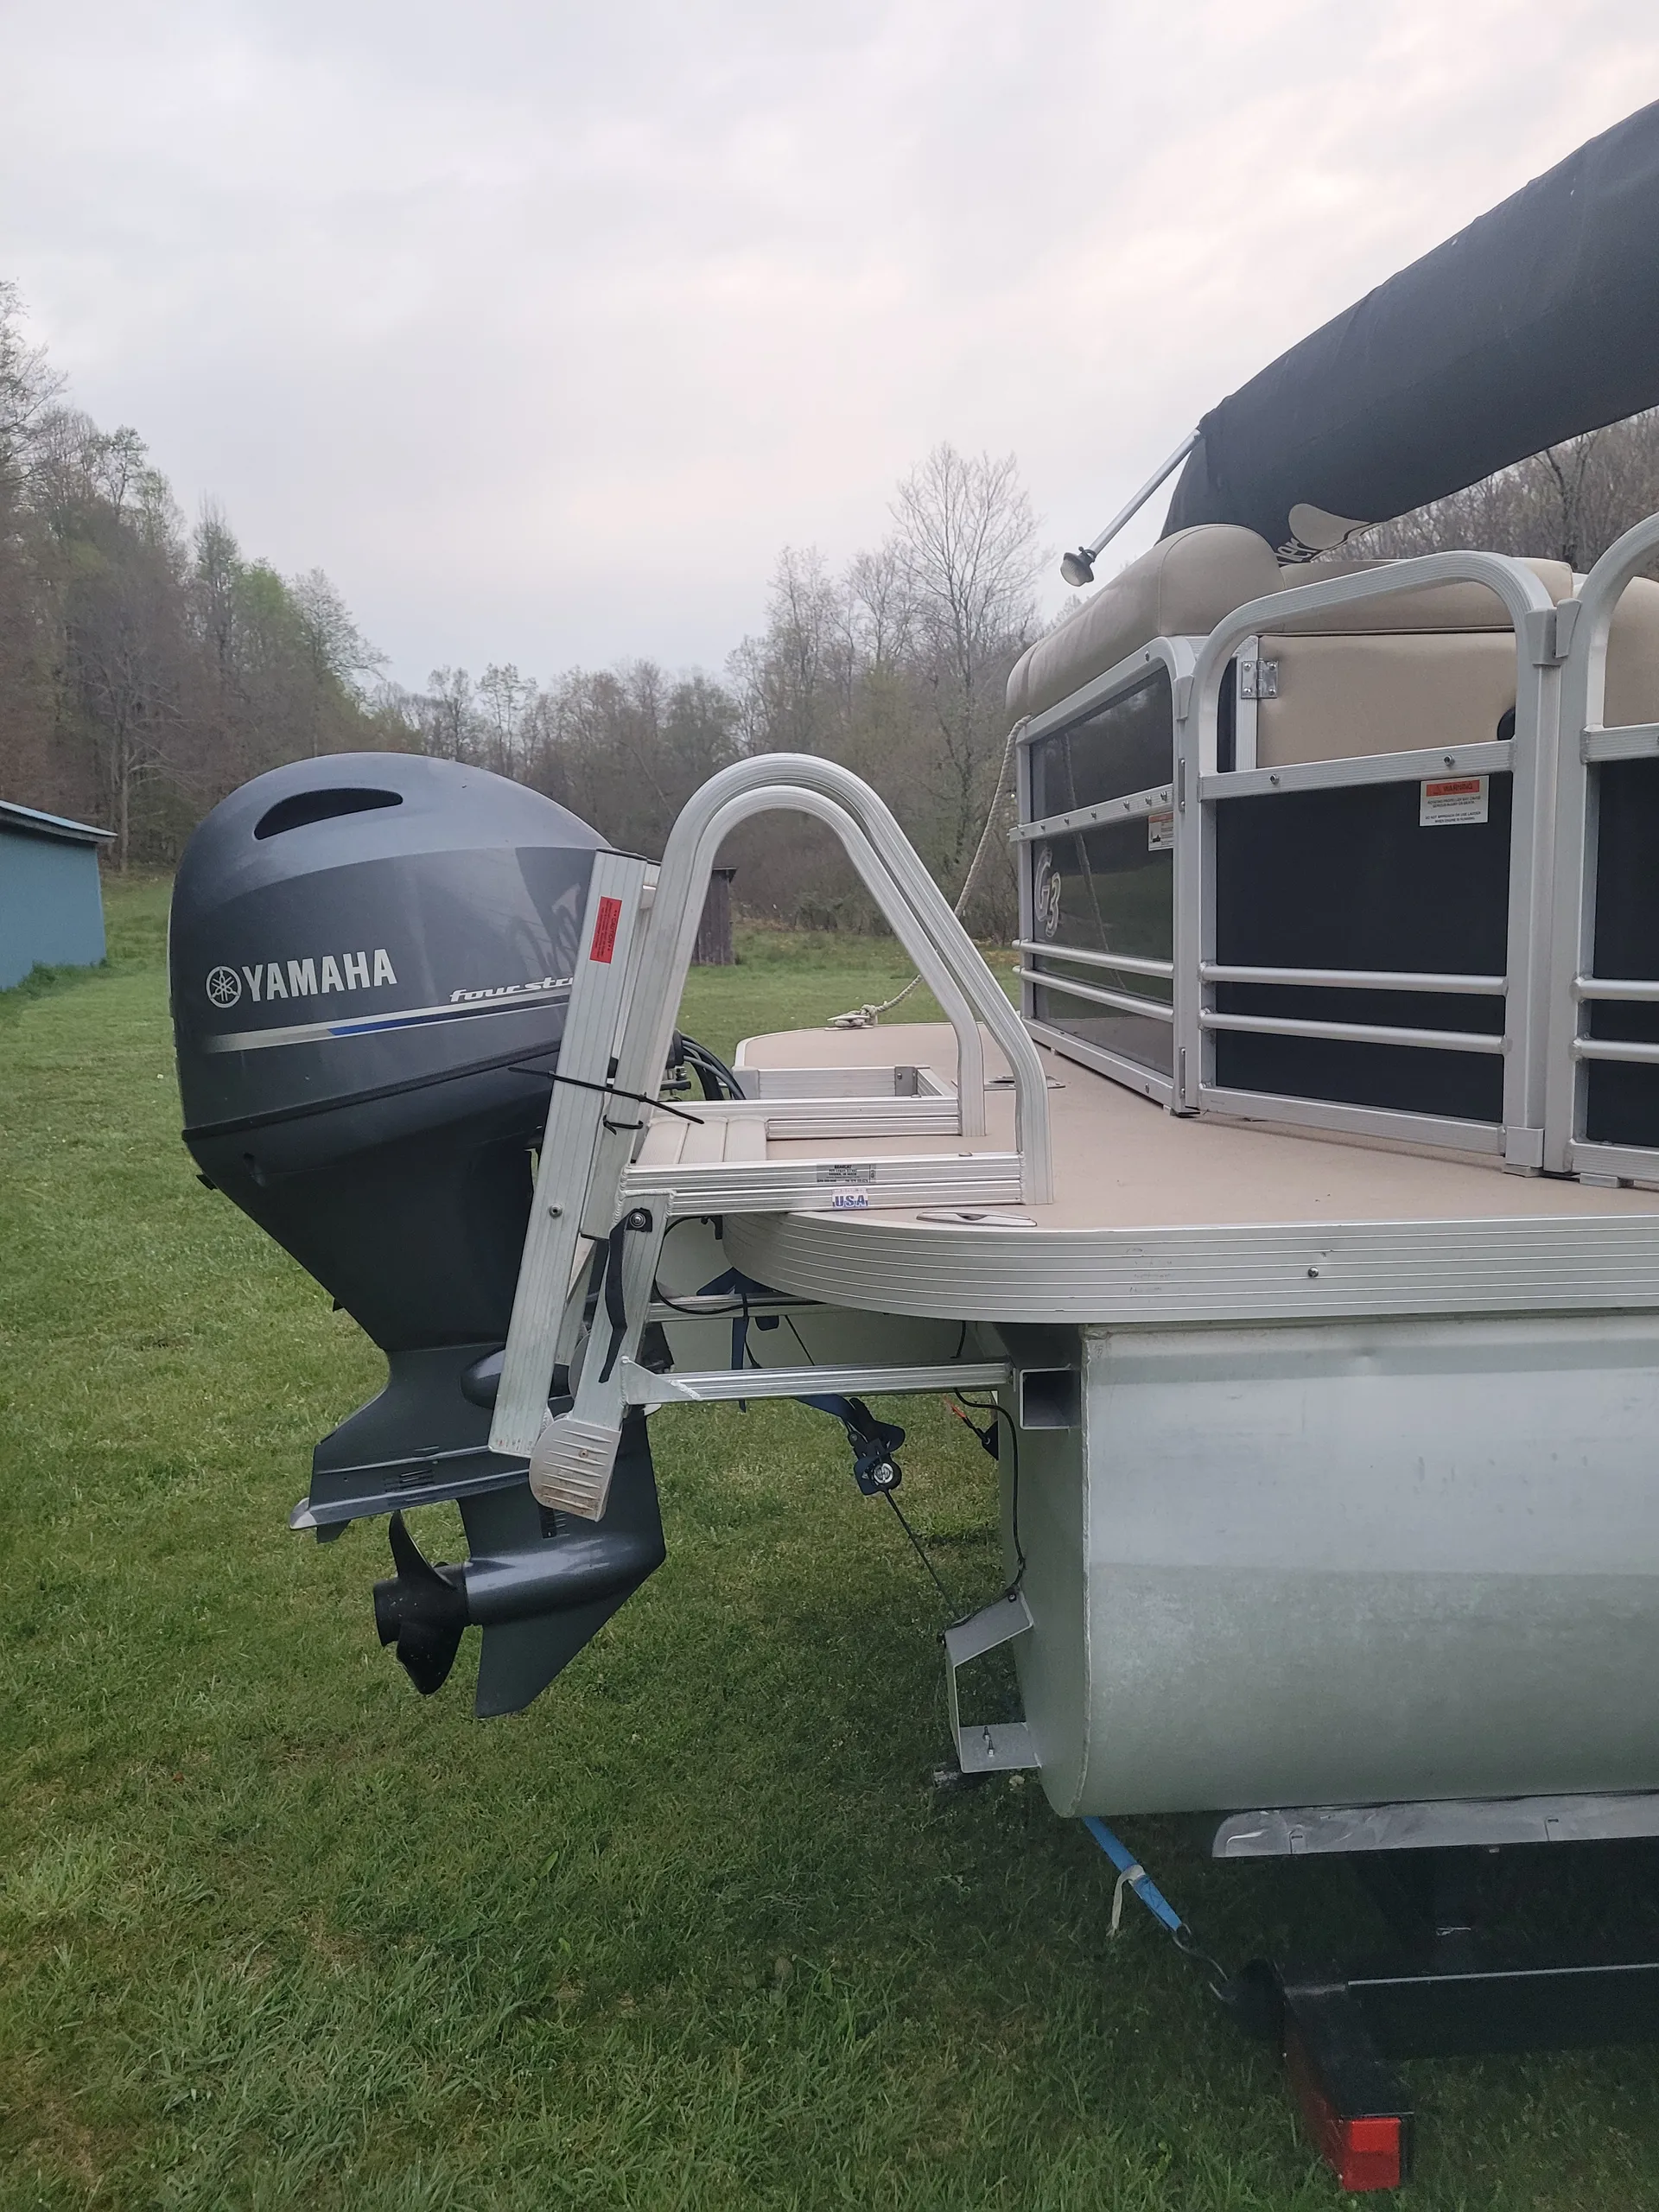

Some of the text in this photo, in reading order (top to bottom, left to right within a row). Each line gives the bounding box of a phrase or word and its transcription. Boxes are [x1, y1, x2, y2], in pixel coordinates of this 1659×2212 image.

[1443, 782, 1473, 791] WARNING
[1034, 845, 1061, 938] G3
[607, 917, 616, 945] CAUTION
[241, 948, 398, 1002] YAMAHA
[835, 1194, 865, 1207] USA
